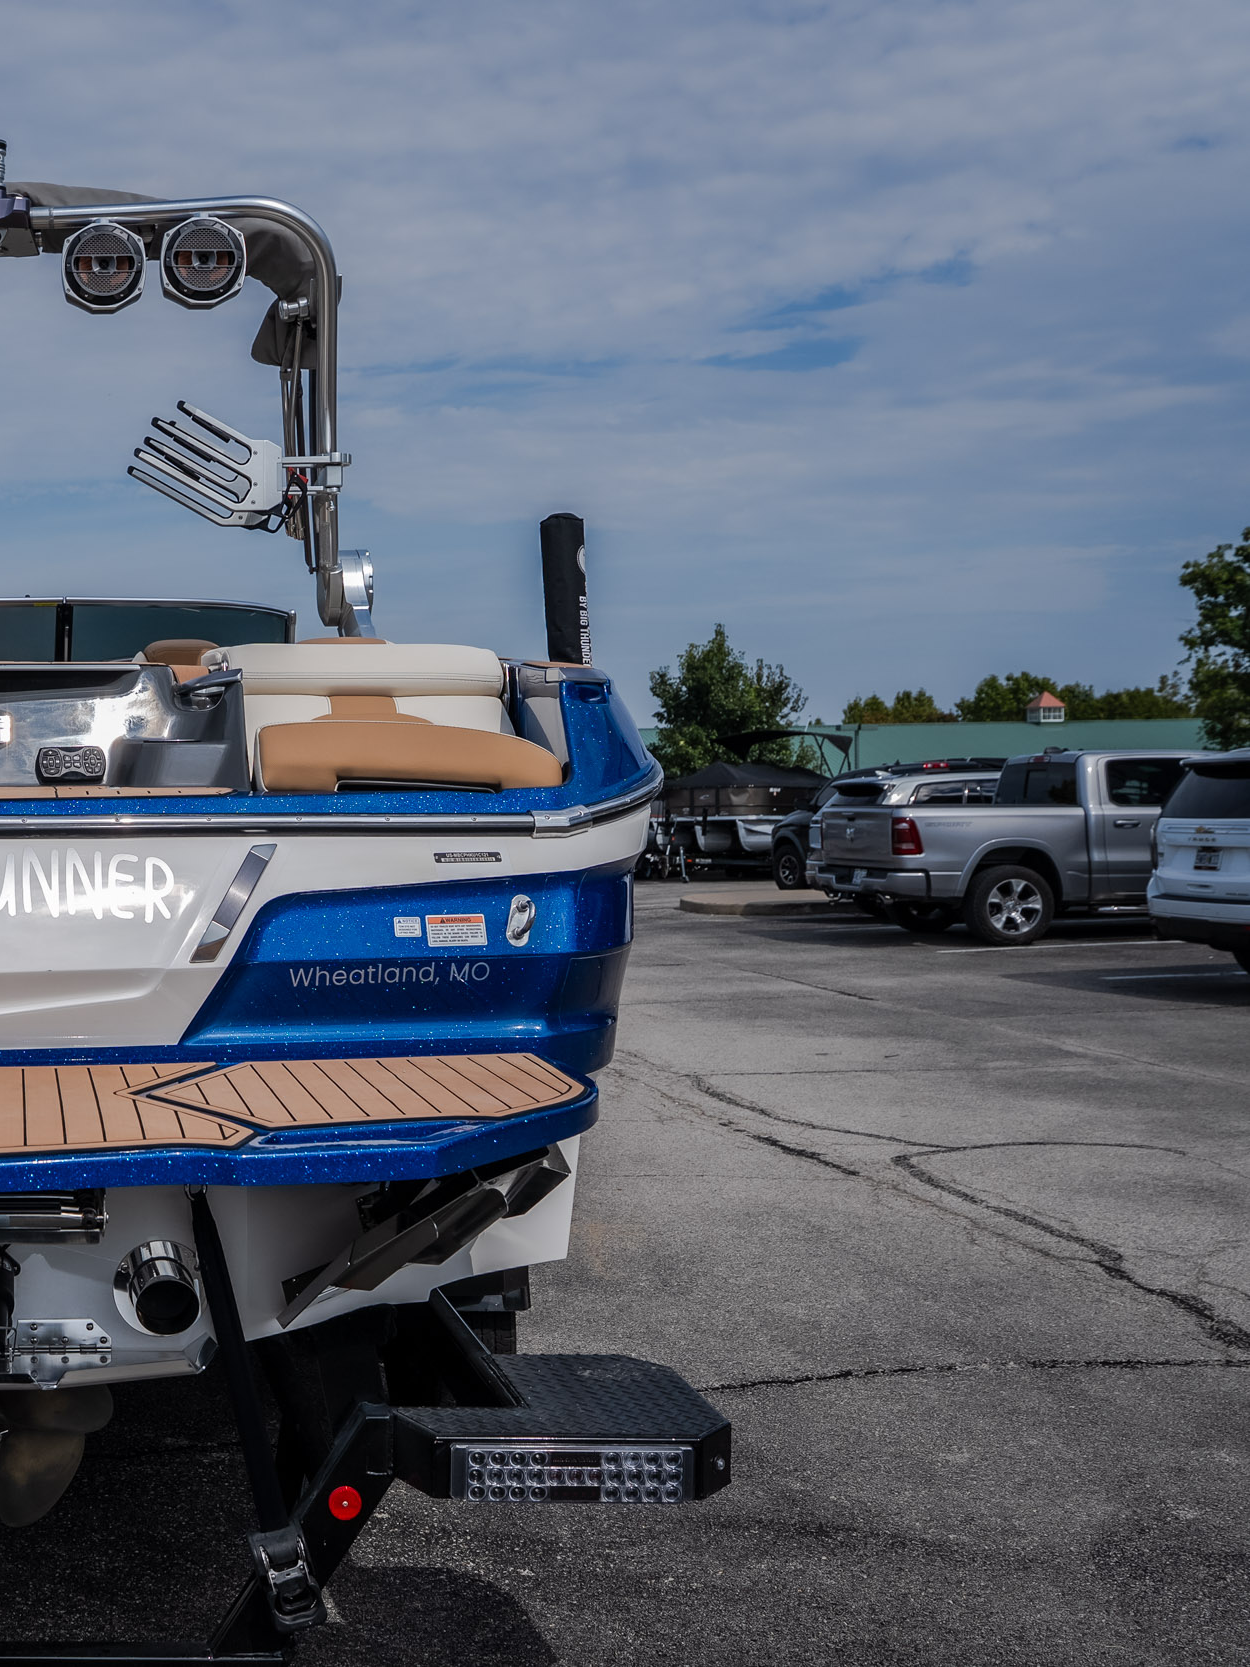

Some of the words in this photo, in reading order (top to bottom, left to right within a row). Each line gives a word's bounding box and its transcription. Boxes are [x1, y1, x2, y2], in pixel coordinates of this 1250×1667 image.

[579, 595, 587, 608] BY
[579, 609, 589, 626] BIG
[289, 961, 440, 988] Wheatland,
[450, 961, 490, 982] MO
